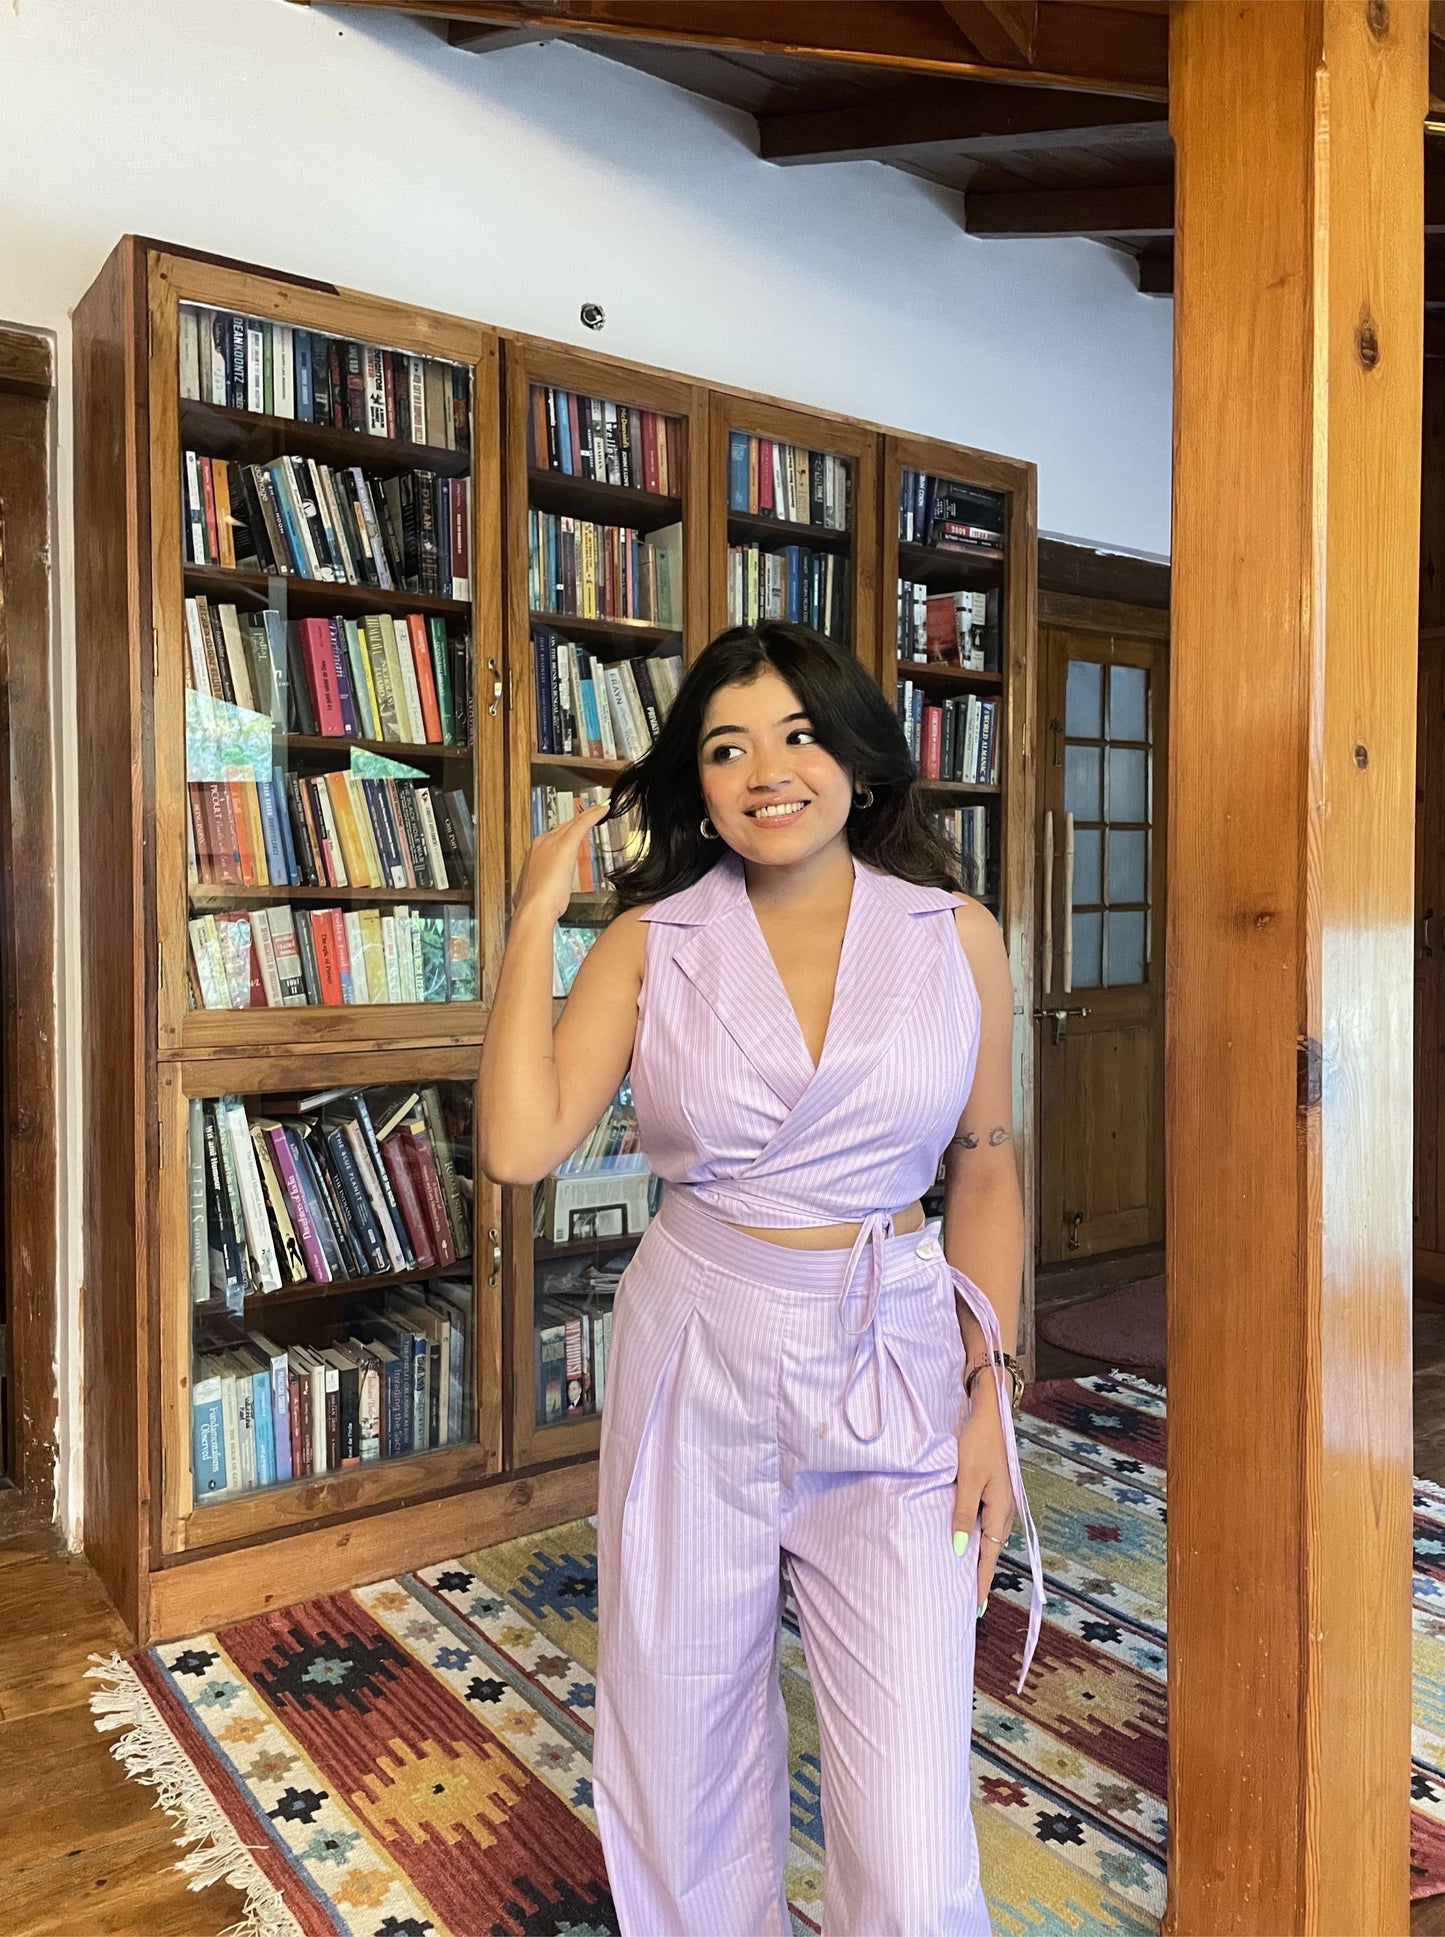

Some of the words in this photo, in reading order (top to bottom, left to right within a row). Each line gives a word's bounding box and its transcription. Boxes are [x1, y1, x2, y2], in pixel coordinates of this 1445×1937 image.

[233, 316, 244, 345] DEAN
[234, 344, 245, 384] KOONTZ
[620, 407, 630, 448] McDonald's
[254, 466, 269, 503] damage
[422, 488, 433, 531] DYLAN
[374, 666, 386, 698] LUARD
[381, 660, 395, 706] NICHOLAS
[609, 673, 623, 705] FRAYN
[982, 714, 990, 740] WORLD
[979, 740, 989, 775] ALMANAC
[210, 784, 223, 819] PICOULT
[403, 779, 411, 796] THE
[405, 796, 416, 822] BLACK
[445, 818, 454, 832] Om
[268, 817, 280, 857] SURVEILLANCE
[411, 822, 420, 844] HOLE
[415, 843, 425, 864] WAR
[334, 922, 344, 946] cobra
[338, 946, 349, 968] road
[205, 1125, 214, 1139] Wit
[208, 1141, 217, 1157] and
[210, 1157, 222, 1191] Humour
[334, 1133, 344, 1149] THE
[341, 1152, 351, 1170] BLUE
[349, 1173, 362, 1202] PLANET
[287, 1175, 298, 1193] India
[291, 1193, 302, 1205] of
[431, 1187, 440, 1204] History
[444, 1161, 457, 1192] ROYAL
[451, 1191, 463, 1221] INDIA
[297, 1203, 312, 1240] Daughters
[566, 1320, 581, 1378] NEWHOUSE
[392, 1369, 402, 1411] Invading
[393, 1413, 403, 1430] the
[200, 1423, 211, 1461] Observed
[209, 1406, 221, 1473] Fundamentalisms
